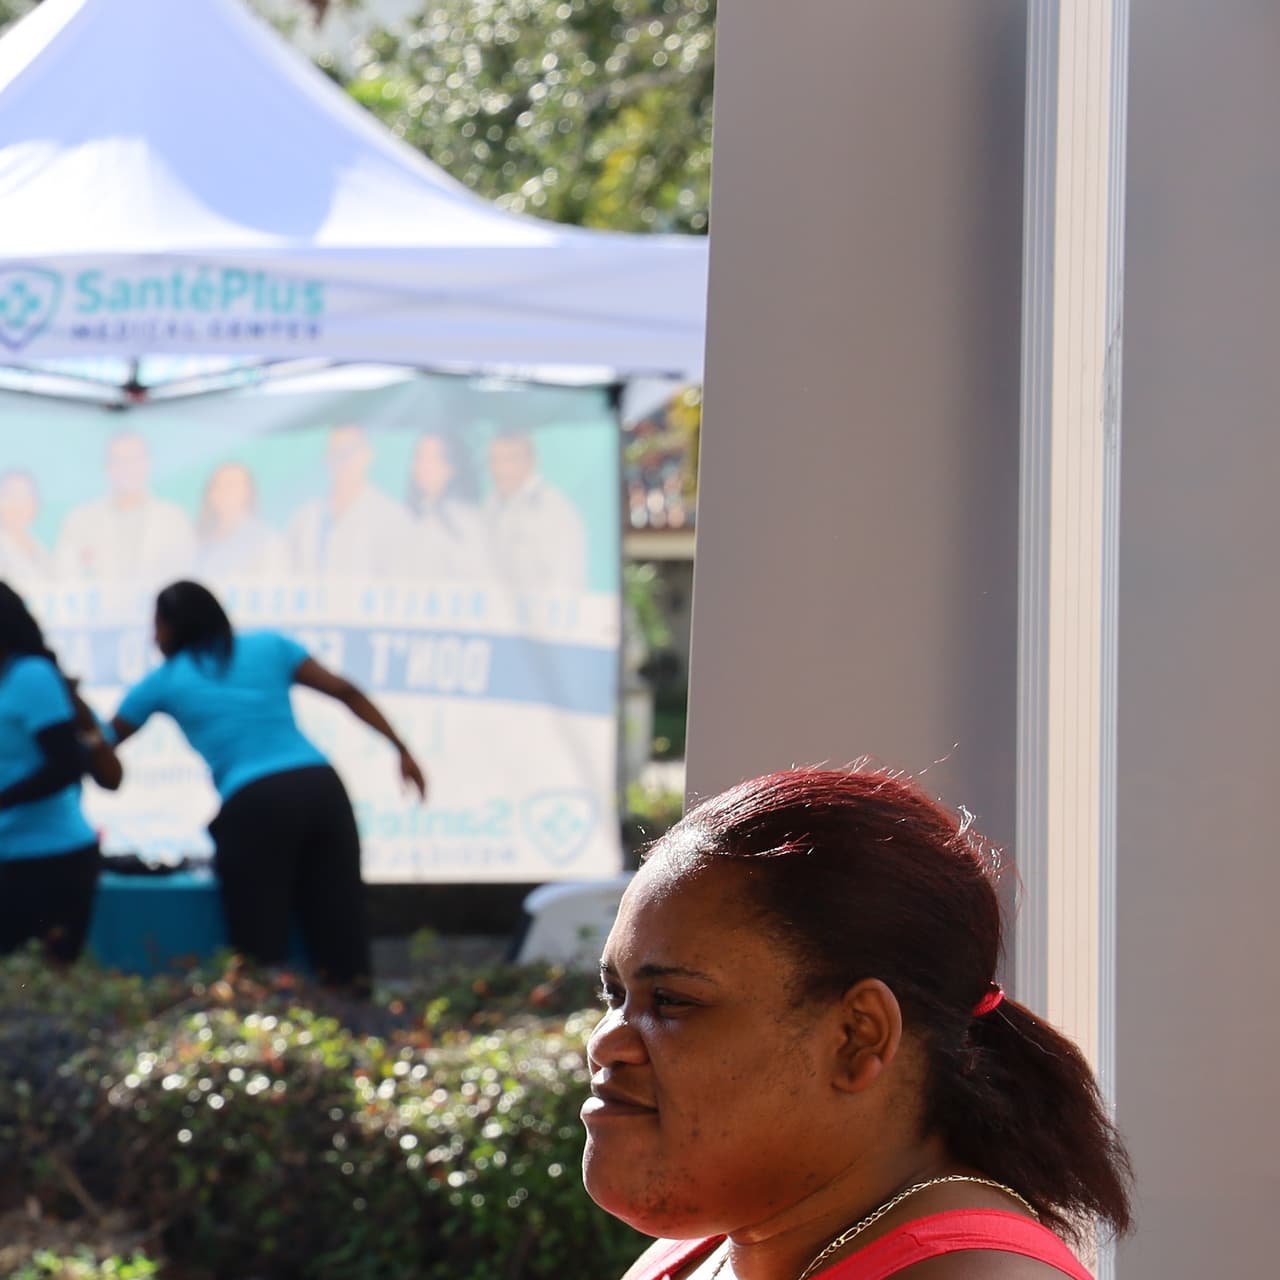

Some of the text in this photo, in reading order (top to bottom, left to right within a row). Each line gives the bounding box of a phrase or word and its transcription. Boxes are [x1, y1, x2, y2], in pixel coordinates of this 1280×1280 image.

[74, 264, 325, 316] SantéPlus
[71, 320, 322, 341] MEDICAL CENTER
